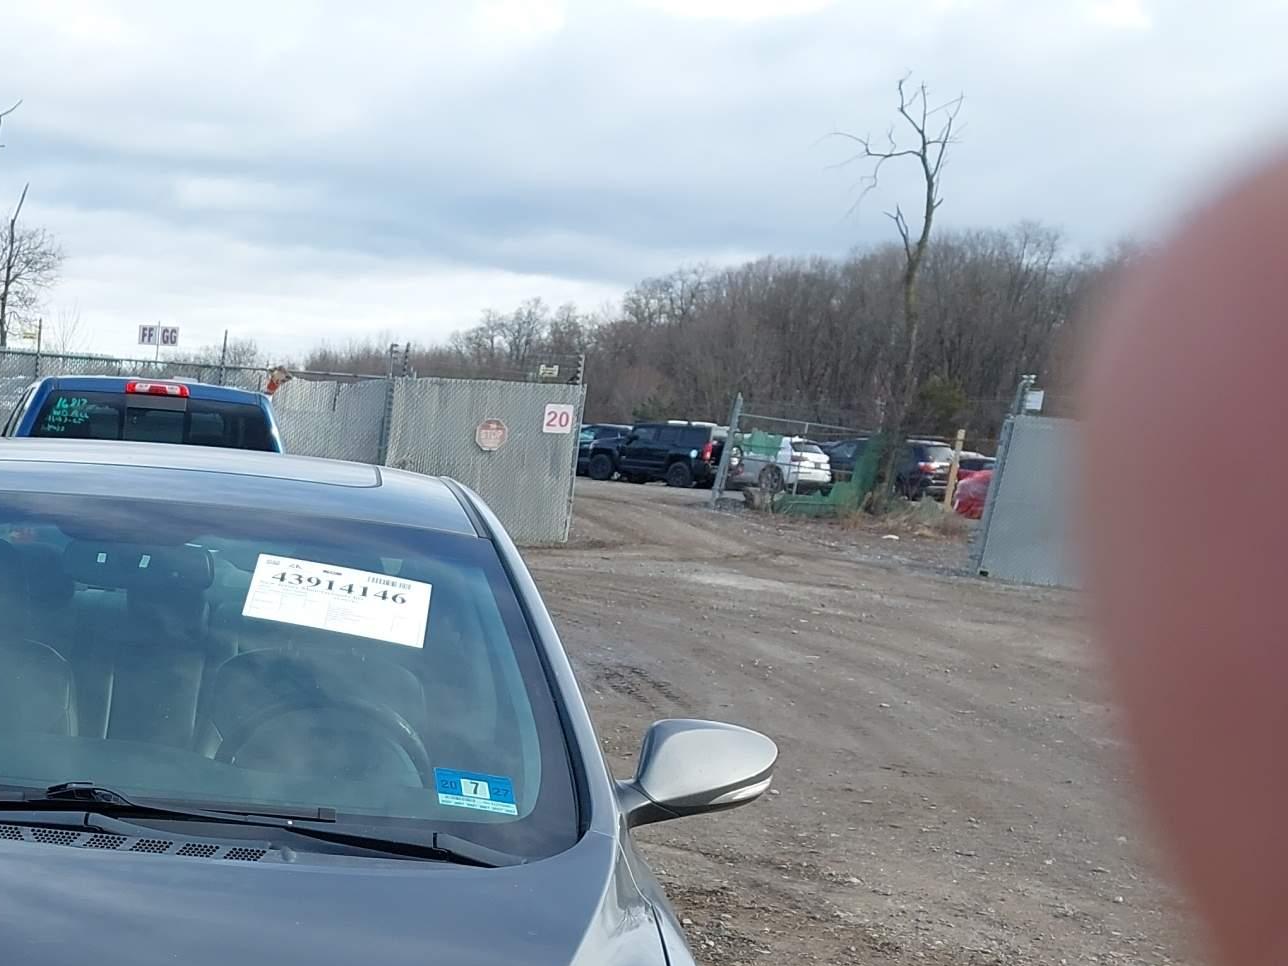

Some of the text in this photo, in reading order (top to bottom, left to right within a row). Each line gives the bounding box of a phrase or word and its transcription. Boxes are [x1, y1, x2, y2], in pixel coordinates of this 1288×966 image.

[141, 326, 154, 343] FF
[162, 328, 177, 345] GG
[546, 410, 569, 428] 20
[271, 571, 407, 605] 43914146
[440, 779, 510, 797] 20 7 27
